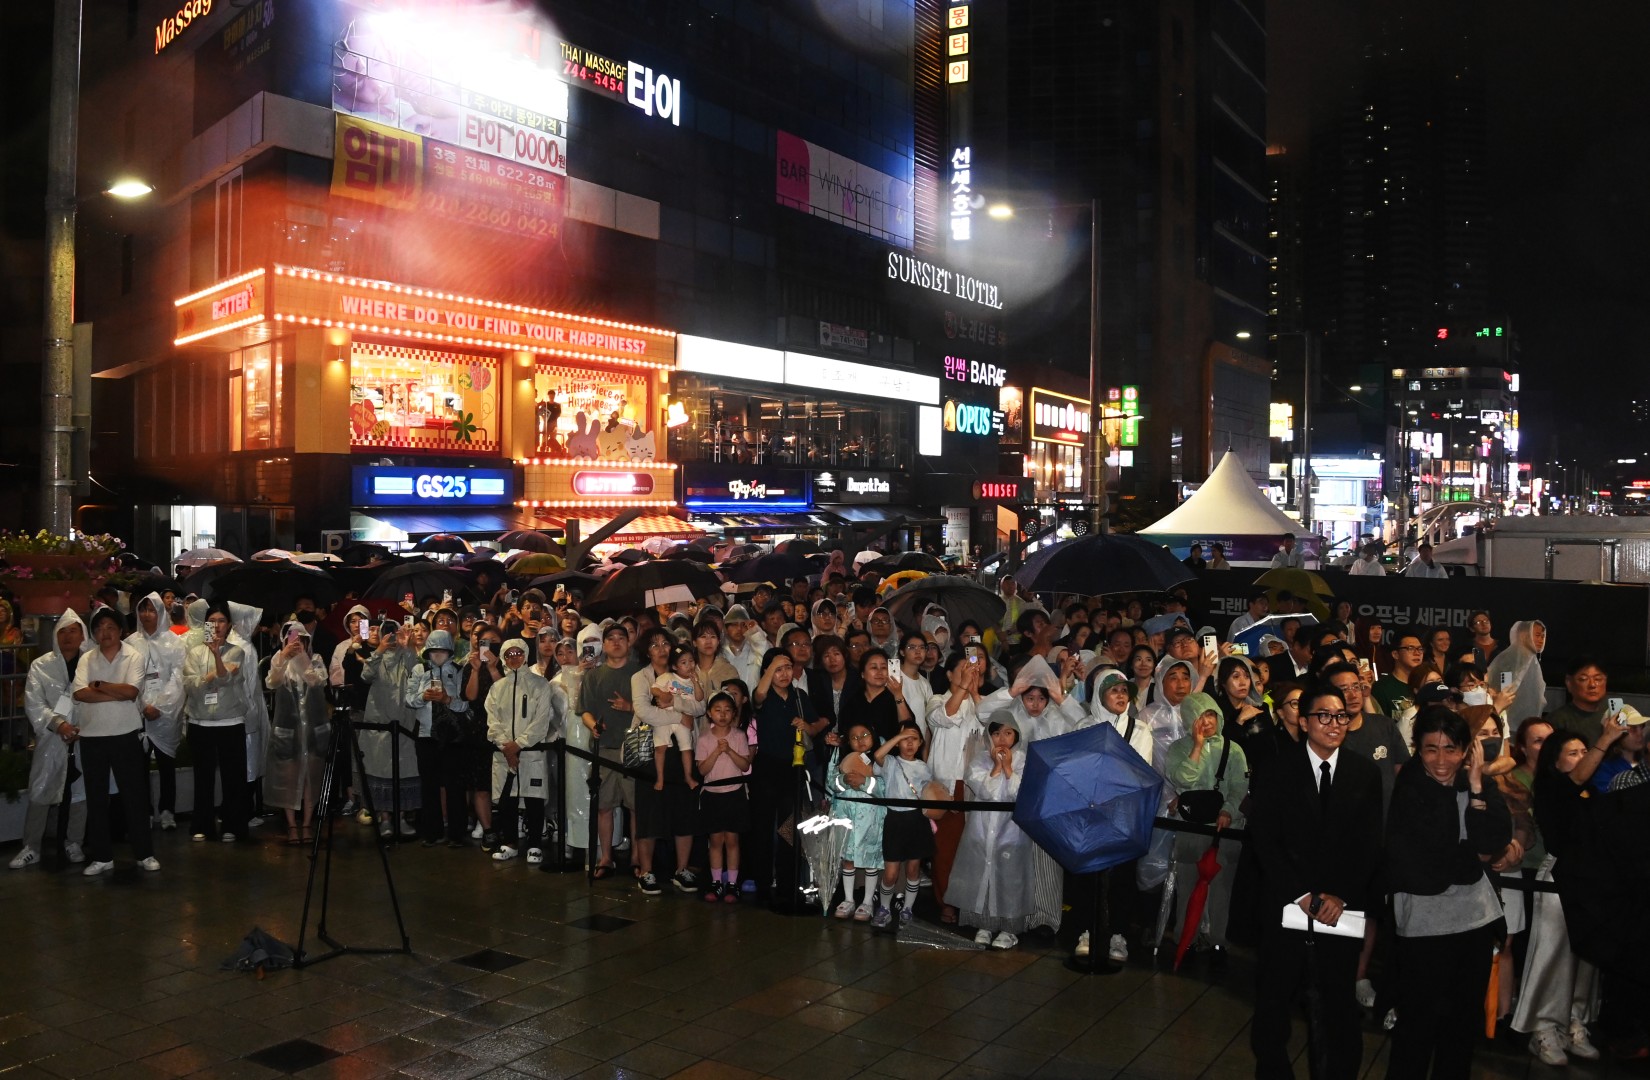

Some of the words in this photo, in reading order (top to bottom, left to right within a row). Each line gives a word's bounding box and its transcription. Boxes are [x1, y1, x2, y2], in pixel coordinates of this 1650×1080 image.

[560, 42, 582, 62] THAI
[952, 9, 967, 81] 몽타이
[563, 60, 624, 94] 744-5454
[627, 60, 681, 127] 타이
[465, 113, 502, 154] 타이
[516, 108, 558, 135] 동일가격
[343, 126, 418, 196] 임대
[464, 155, 491, 174] 전체
[780, 158, 807, 185] BAR
[951, 146, 971, 241] 선셋호텔
[466, 202, 511, 227] 2860
[517, 214, 559, 239] 0424
[888, 251, 951, 294] SUNSET
[955, 272, 1003, 310] HOTEL
[341, 295, 407, 321] WHERE
[414, 306, 439, 325] DO
[445, 311, 479, 331] YOU
[484, 317, 520, 336] FIND
[525, 322, 564, 342] YOUR
[569, 329, 646, 354] HAPPINESS?
[557, 385, 563, 396] A
[565, 381, 589, 395] Little
[590, 384, 613, 398] Piece
[568, 396, 613, 412] Happiness
[956, 403, 990, 436] OPUS
[416, 474, 467, 498] GS25
[981, 483, 1019, 497] SUNSET
[326, 534, 344, 552] P
[1415, 606, 1490, 632] 세리머
